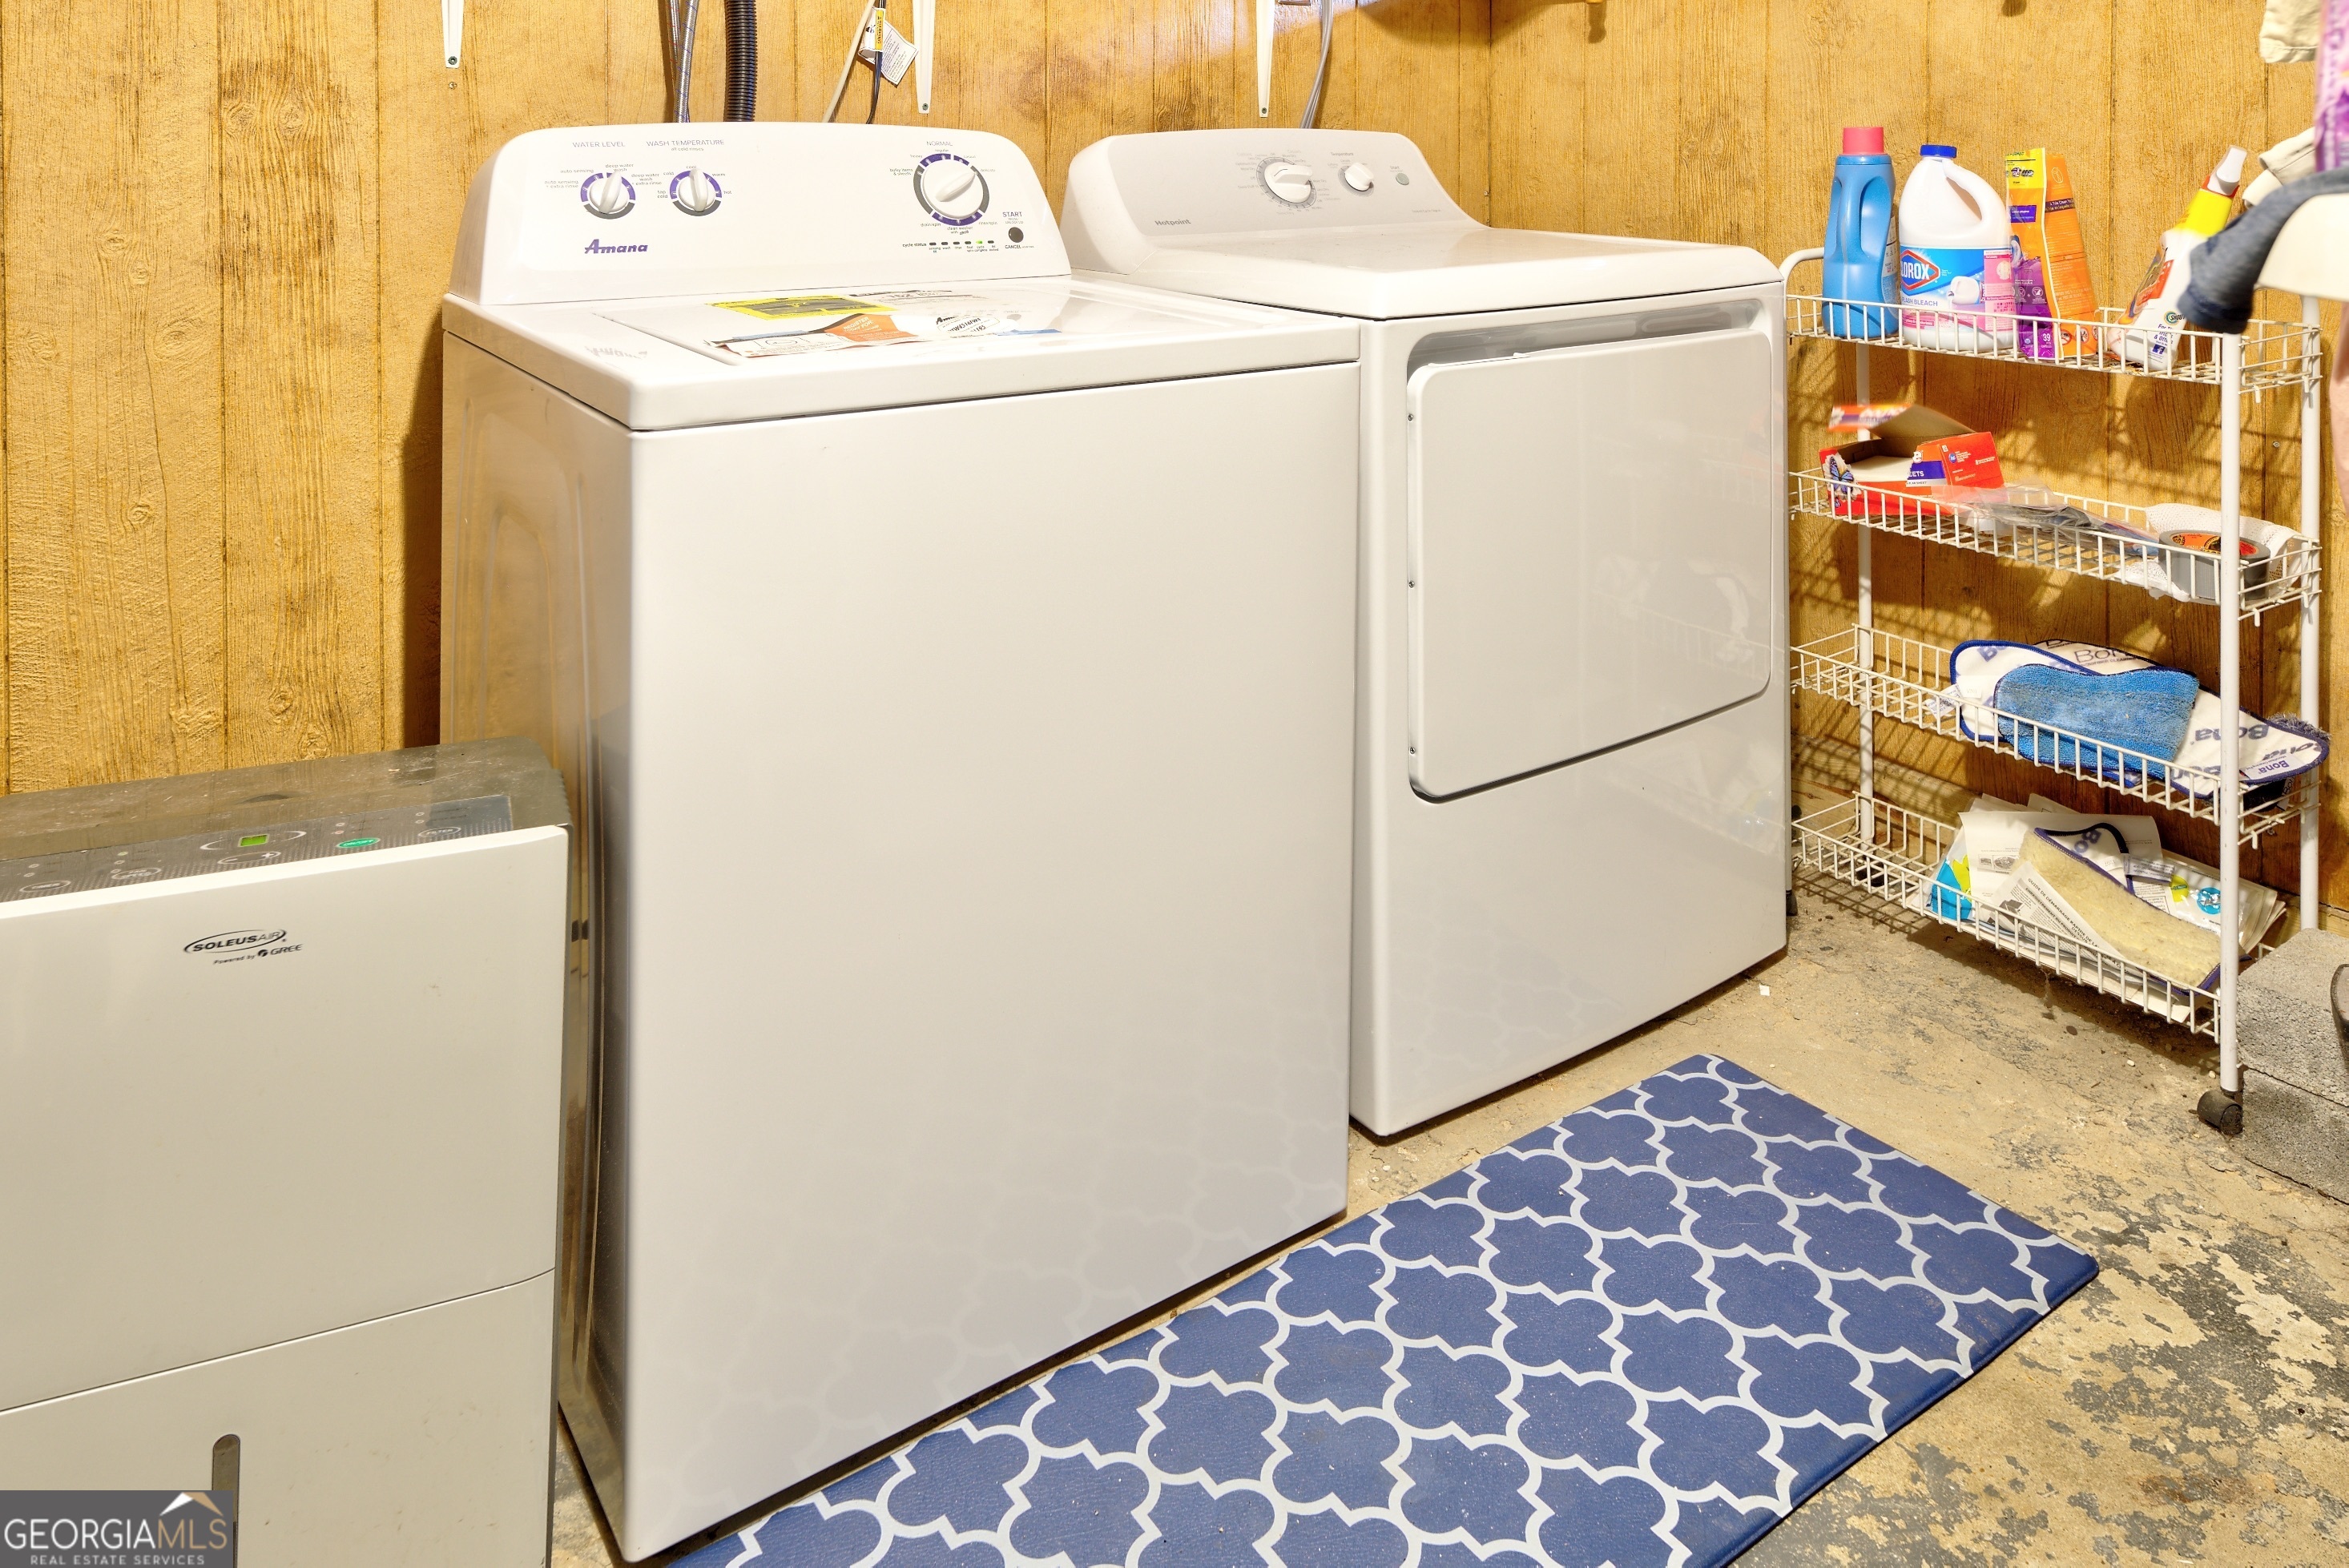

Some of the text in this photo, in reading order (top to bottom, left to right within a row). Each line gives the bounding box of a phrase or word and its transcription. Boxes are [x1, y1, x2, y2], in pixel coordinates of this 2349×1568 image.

[584, 238, 649, 255] Amana
[1914, 299, 1939, 307] BLEACH
[843, 316, 869, 330] REGISTER
[2043, 333, 2051, 342] 39
[2258, 760, 2290, 774] Bona
[2025, 887, 2056, 918] ENREGISTREMENT
[2028, 877, 2041, 892] GUIDE
[2045, 896, 2070, 921] DÉMARRAGE
[2069, 920, 2086, 937] RAPIDE
[213, 955, 245, 965] Powered
[270, 944, 304, 956] GREE
